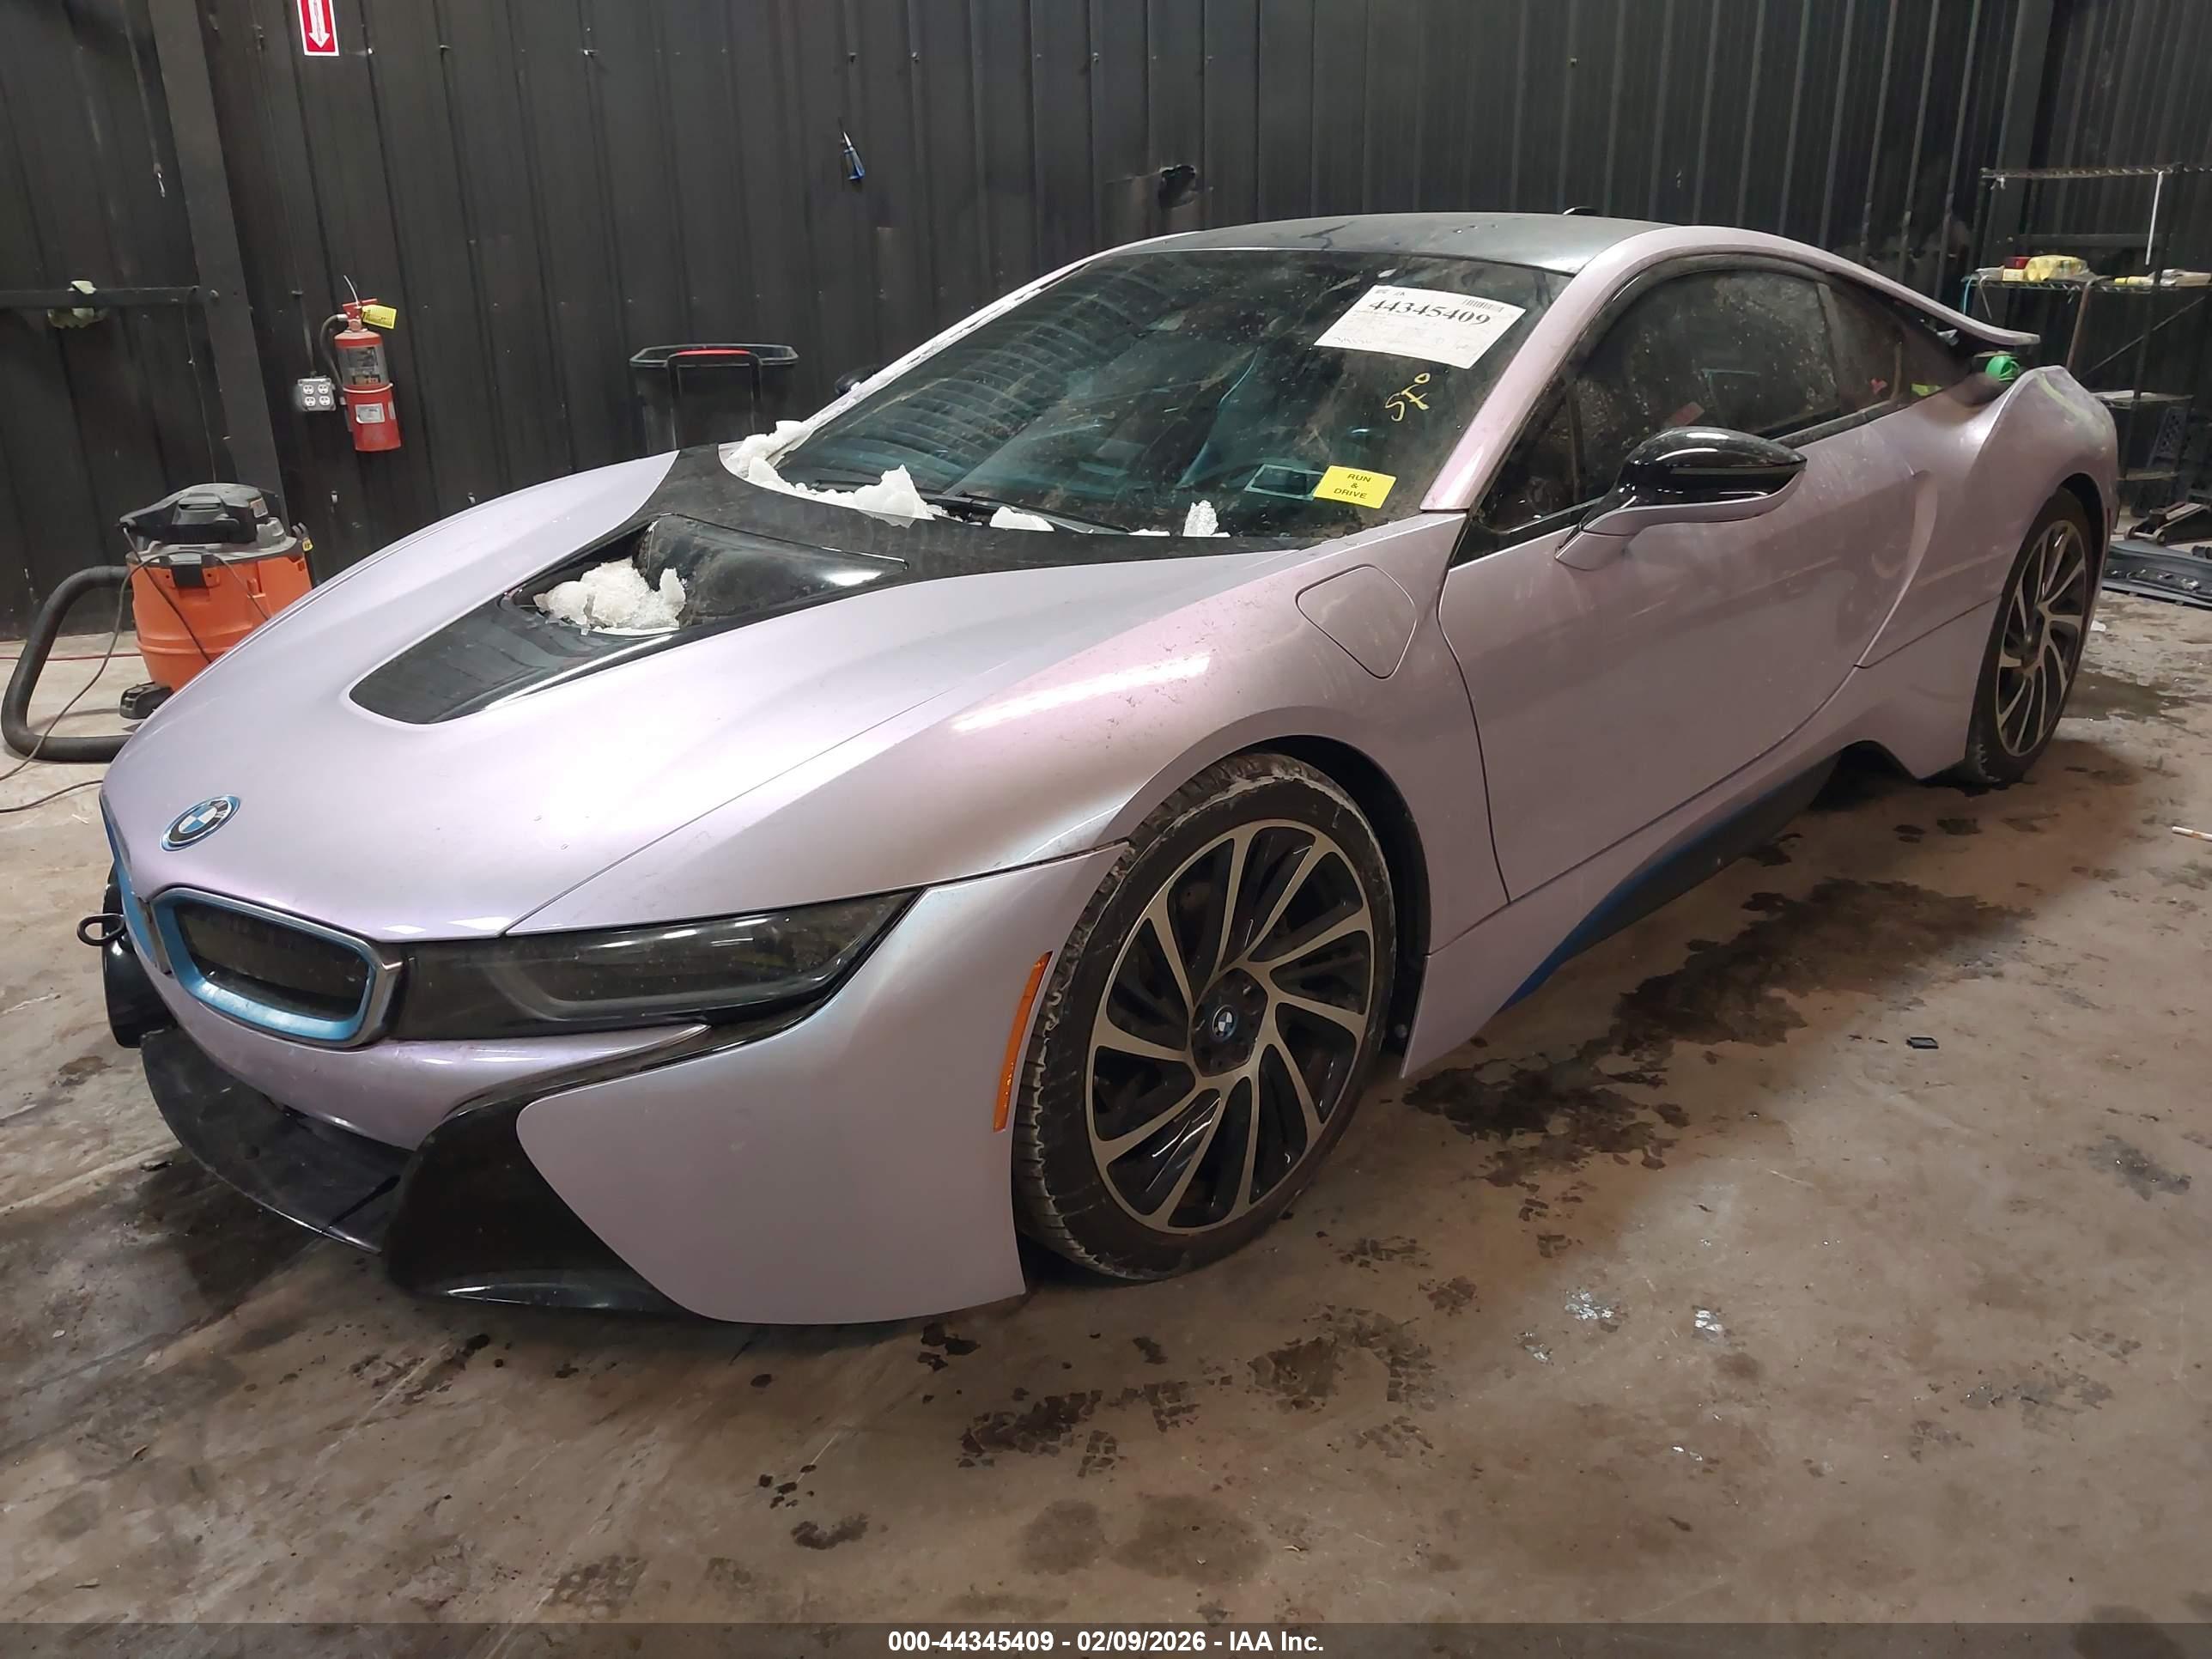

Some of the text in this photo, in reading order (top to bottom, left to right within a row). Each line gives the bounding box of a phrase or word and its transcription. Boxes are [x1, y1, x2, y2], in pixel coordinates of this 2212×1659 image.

[1369, 300, 1491, 325] 44345409
[1346, 473, 1372, 483] RUN
[1334, 488, 1367, 499] DRIVE
